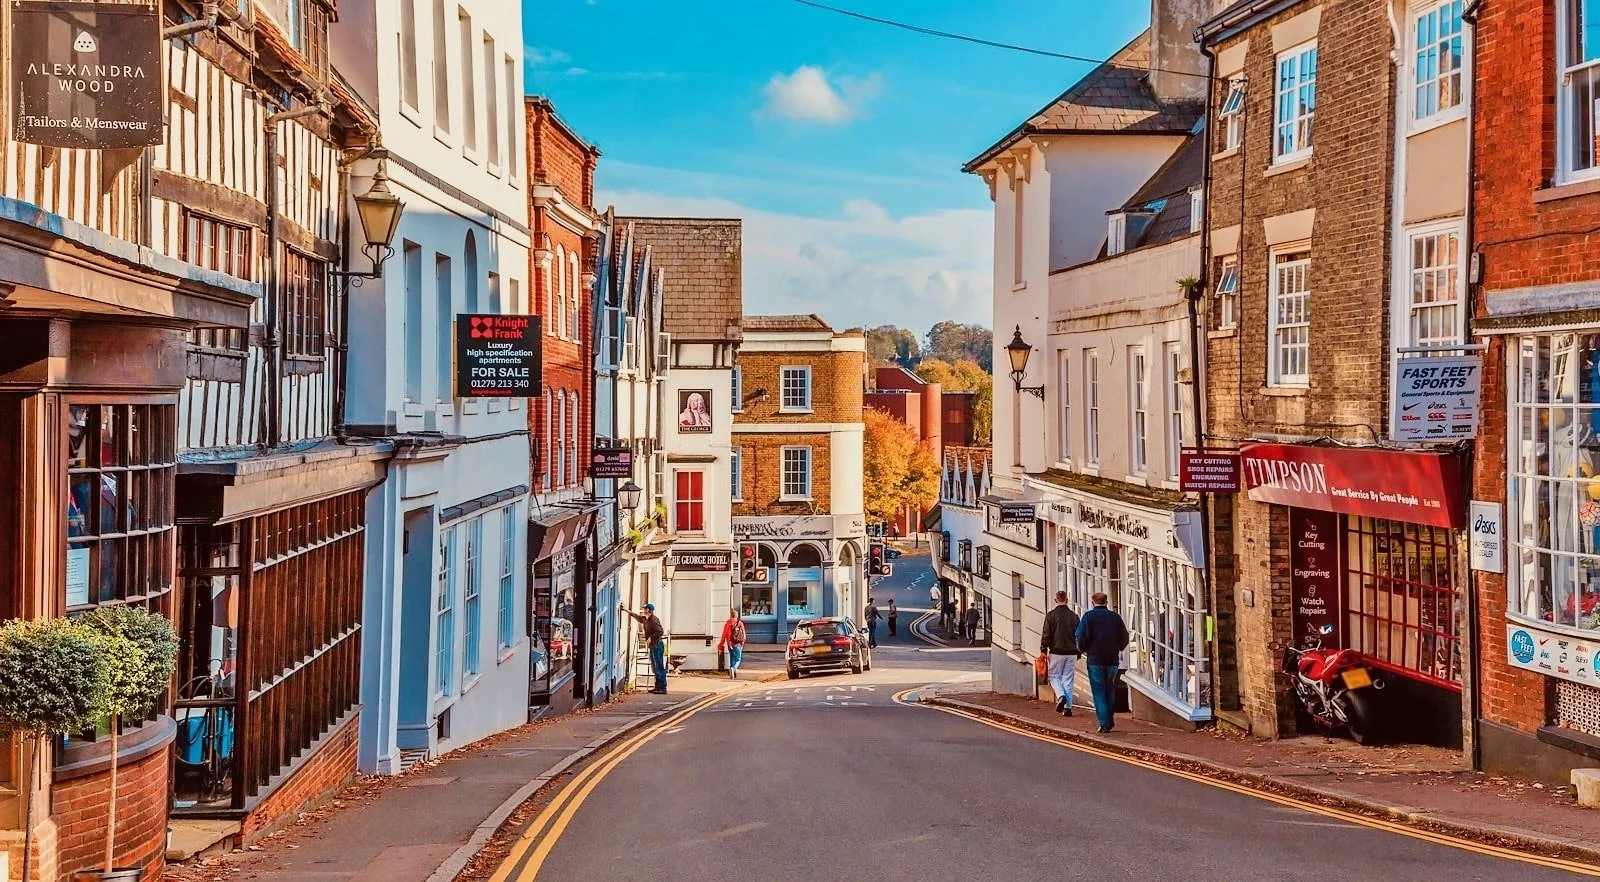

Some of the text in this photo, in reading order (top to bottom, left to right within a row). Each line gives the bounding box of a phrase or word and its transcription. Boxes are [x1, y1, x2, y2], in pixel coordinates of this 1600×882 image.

[27, 63, 145, 78] ALEXANDRA
[59, 80, 114, 93] WOOD
[26, 116, 148, 130] Tailors & Menswear
[495, 317, 528, 329] Knight
[495, 329, 523, 339] Frank
[487, 342, 513, 350] Luxury
[467, 349, 533, 358] high specification
[471, 368, 529, 377] FOR SALE
[1402, 366, 1476, 379] FAST FEET
[471, 379, 529, 388] 01279 213 340
[1412, 378, 1467, 389] SPORTS
[1246, 457, 1327, 494] TIMPSON
[1331, 487, 1418, 506] Great Service By Great People
[1305, 532, 1318, 540] Key
[1298, 541, 1325, 550] Cutting
[681, 556, 706, 564] GEORGE
[708, 556, 728, 564] HOTEL
[1294, 569, 1330, 579] Engraving
[1300, 607, 1326, 616] Repairs
[1514, 635, 1527, 644] FAST
[1521, 644, 1533, 653] FEET
